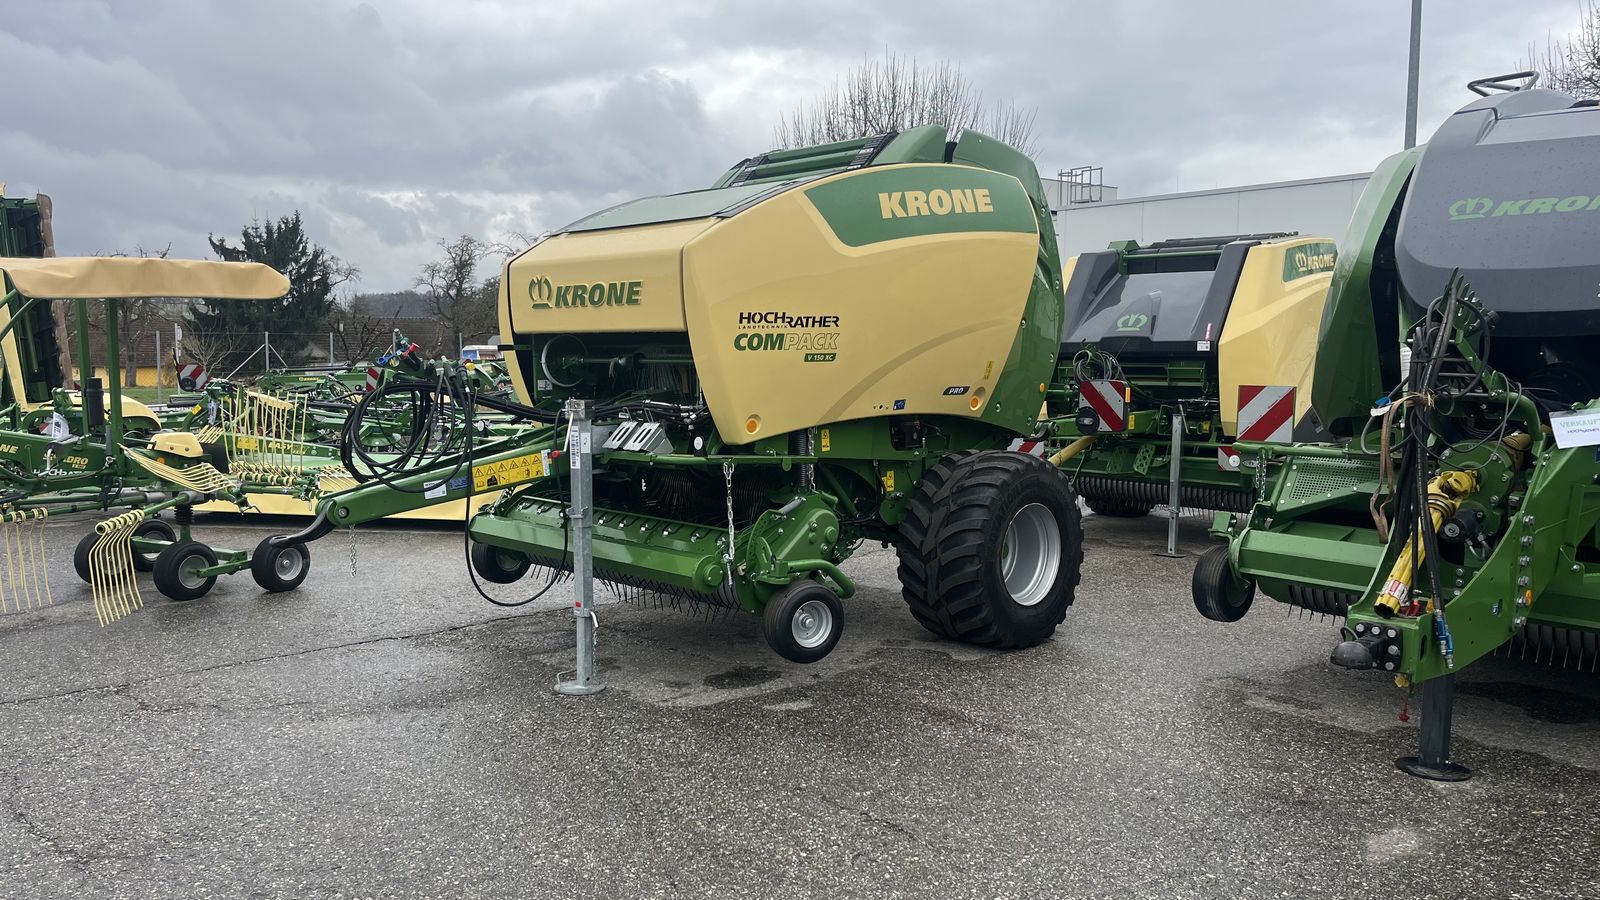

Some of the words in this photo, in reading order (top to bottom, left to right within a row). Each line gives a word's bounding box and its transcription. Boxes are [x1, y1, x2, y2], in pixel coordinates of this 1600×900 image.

[878, 188, 994, 219] KRONE
[1307, 253, 1335, 270] KRONE
[555, 280, 643, 309] KRONE
[739, 312, 840, 328] HOCHRATHER
[734, 333, 840, 352] COMPACK
[948, 387, 964, 395] PRO
